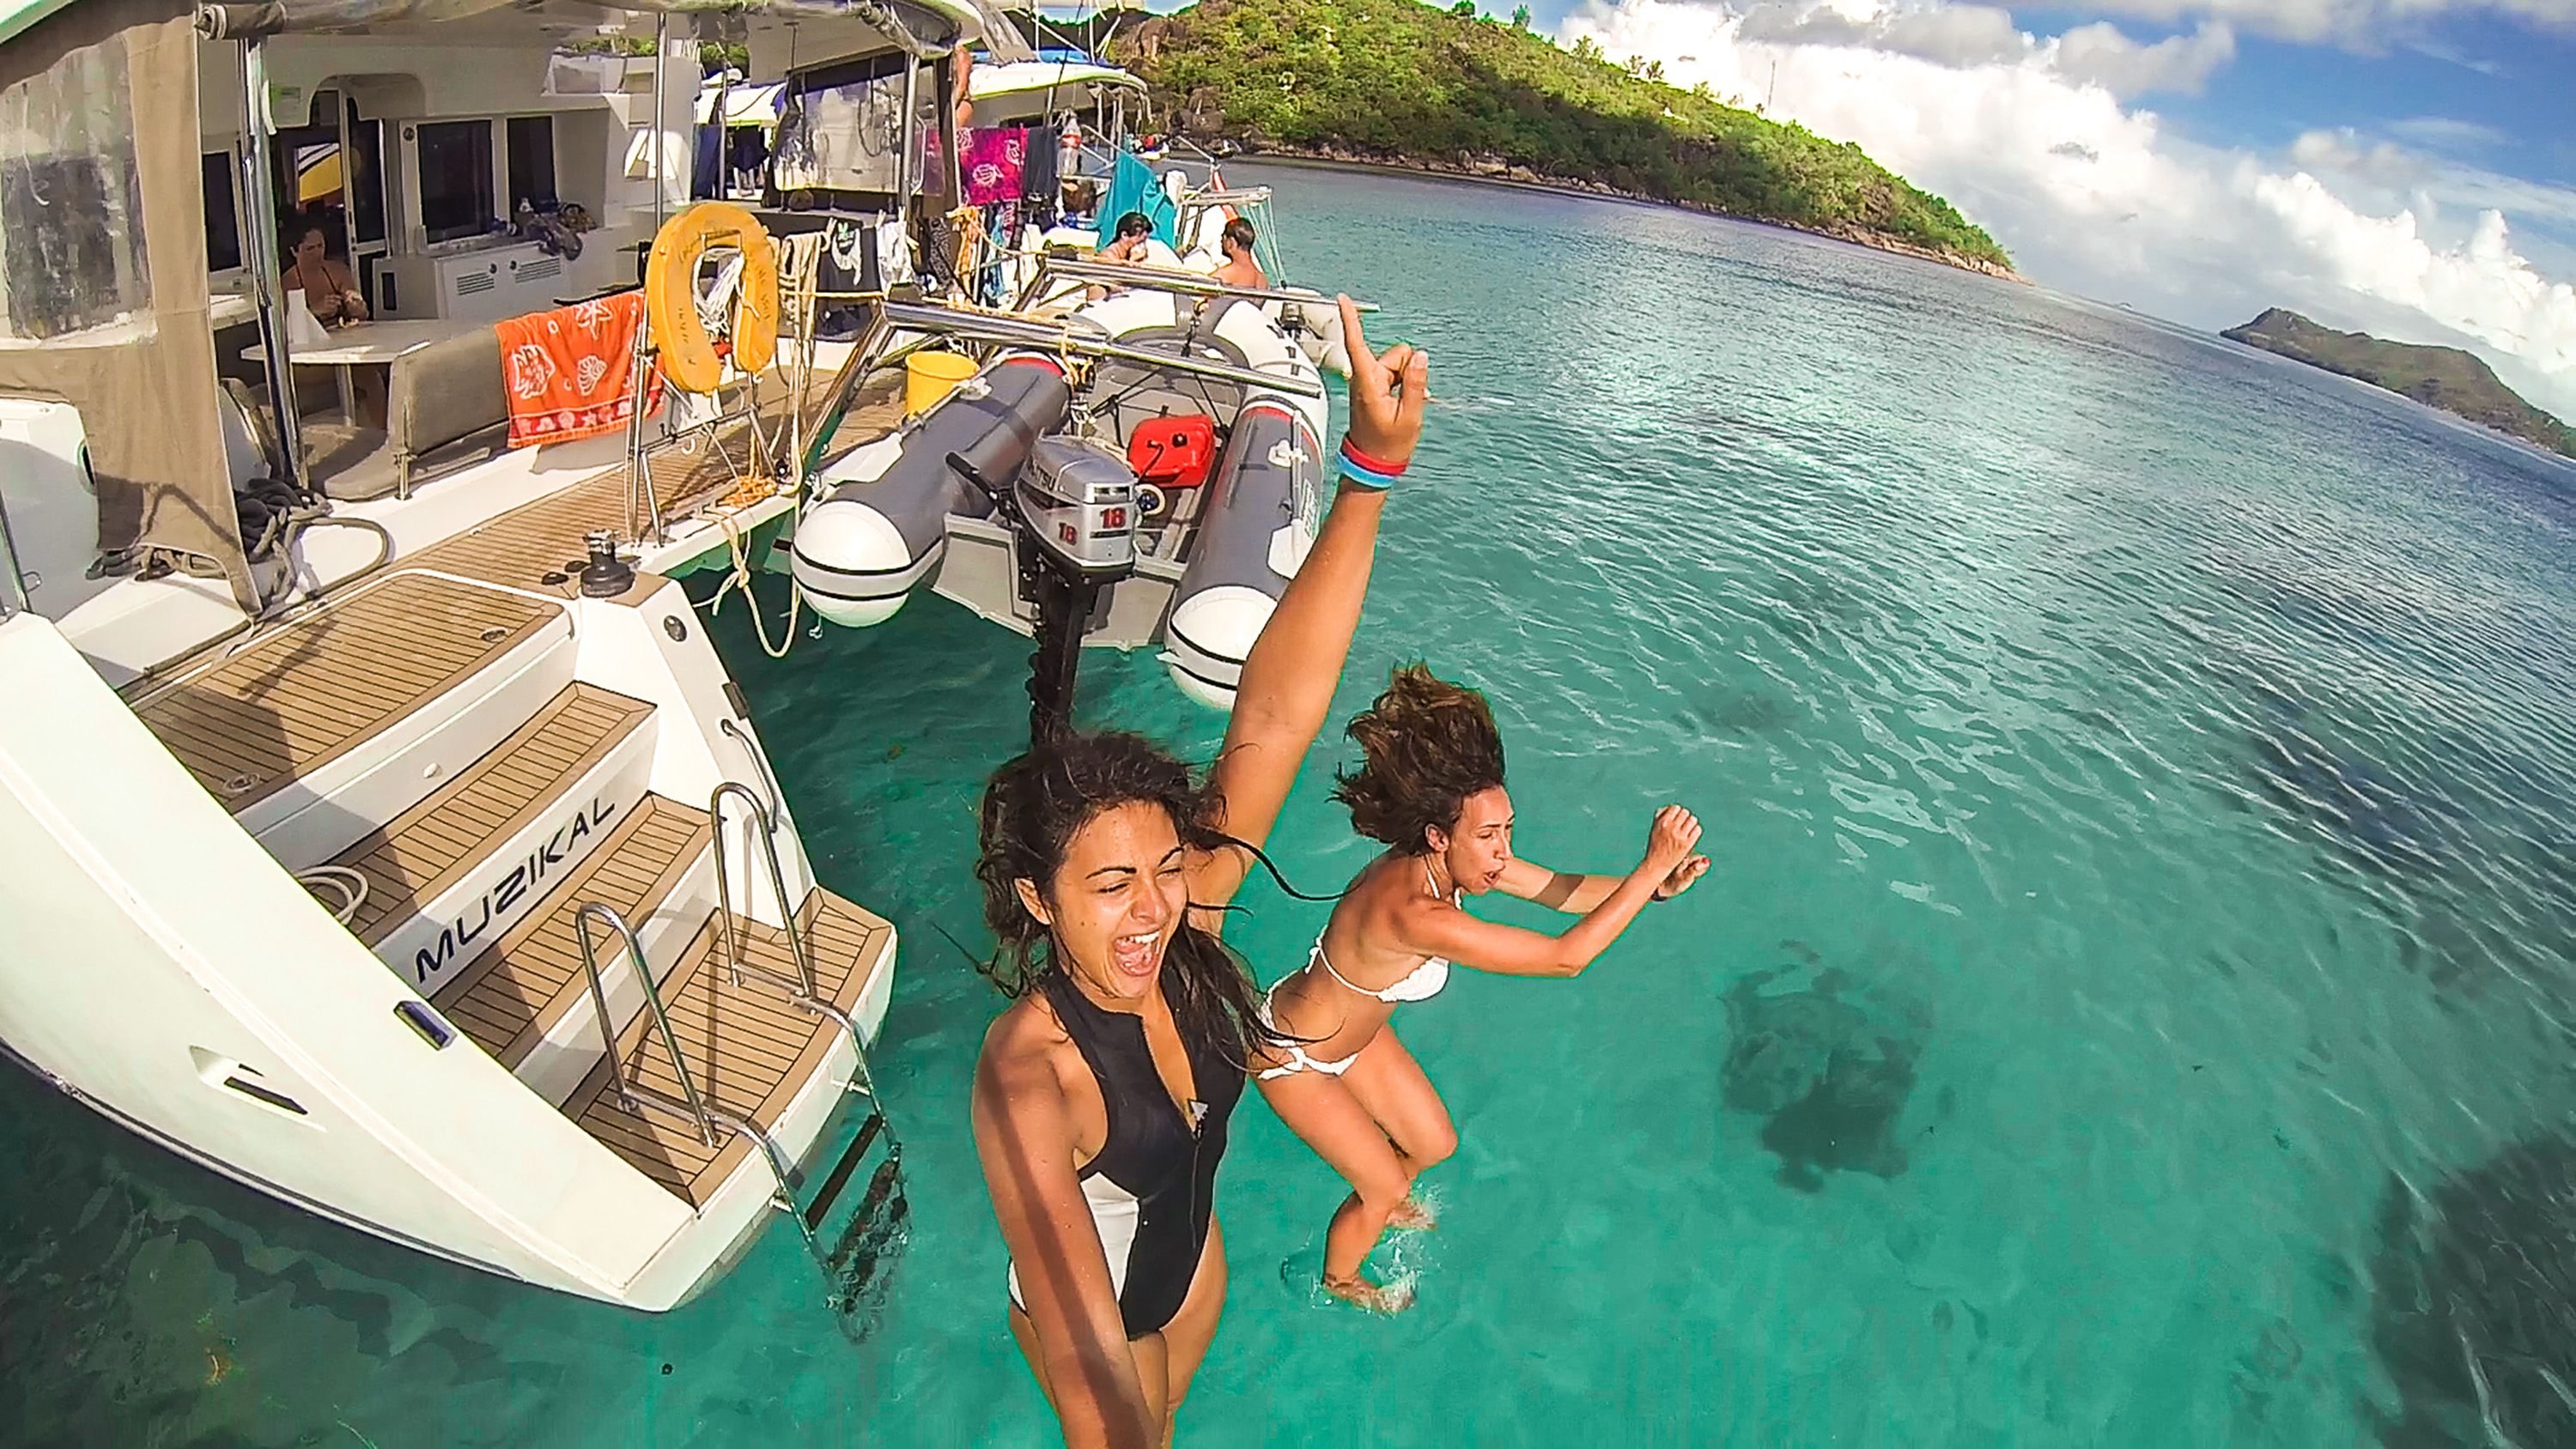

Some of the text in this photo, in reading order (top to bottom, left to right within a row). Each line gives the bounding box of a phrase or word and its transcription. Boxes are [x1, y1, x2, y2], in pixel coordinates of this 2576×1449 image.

[1100, 507, 1127, 529] 18
[1058, 522, 1078, 545] 18
[415, 797, 616, 984] MUZIKAL
